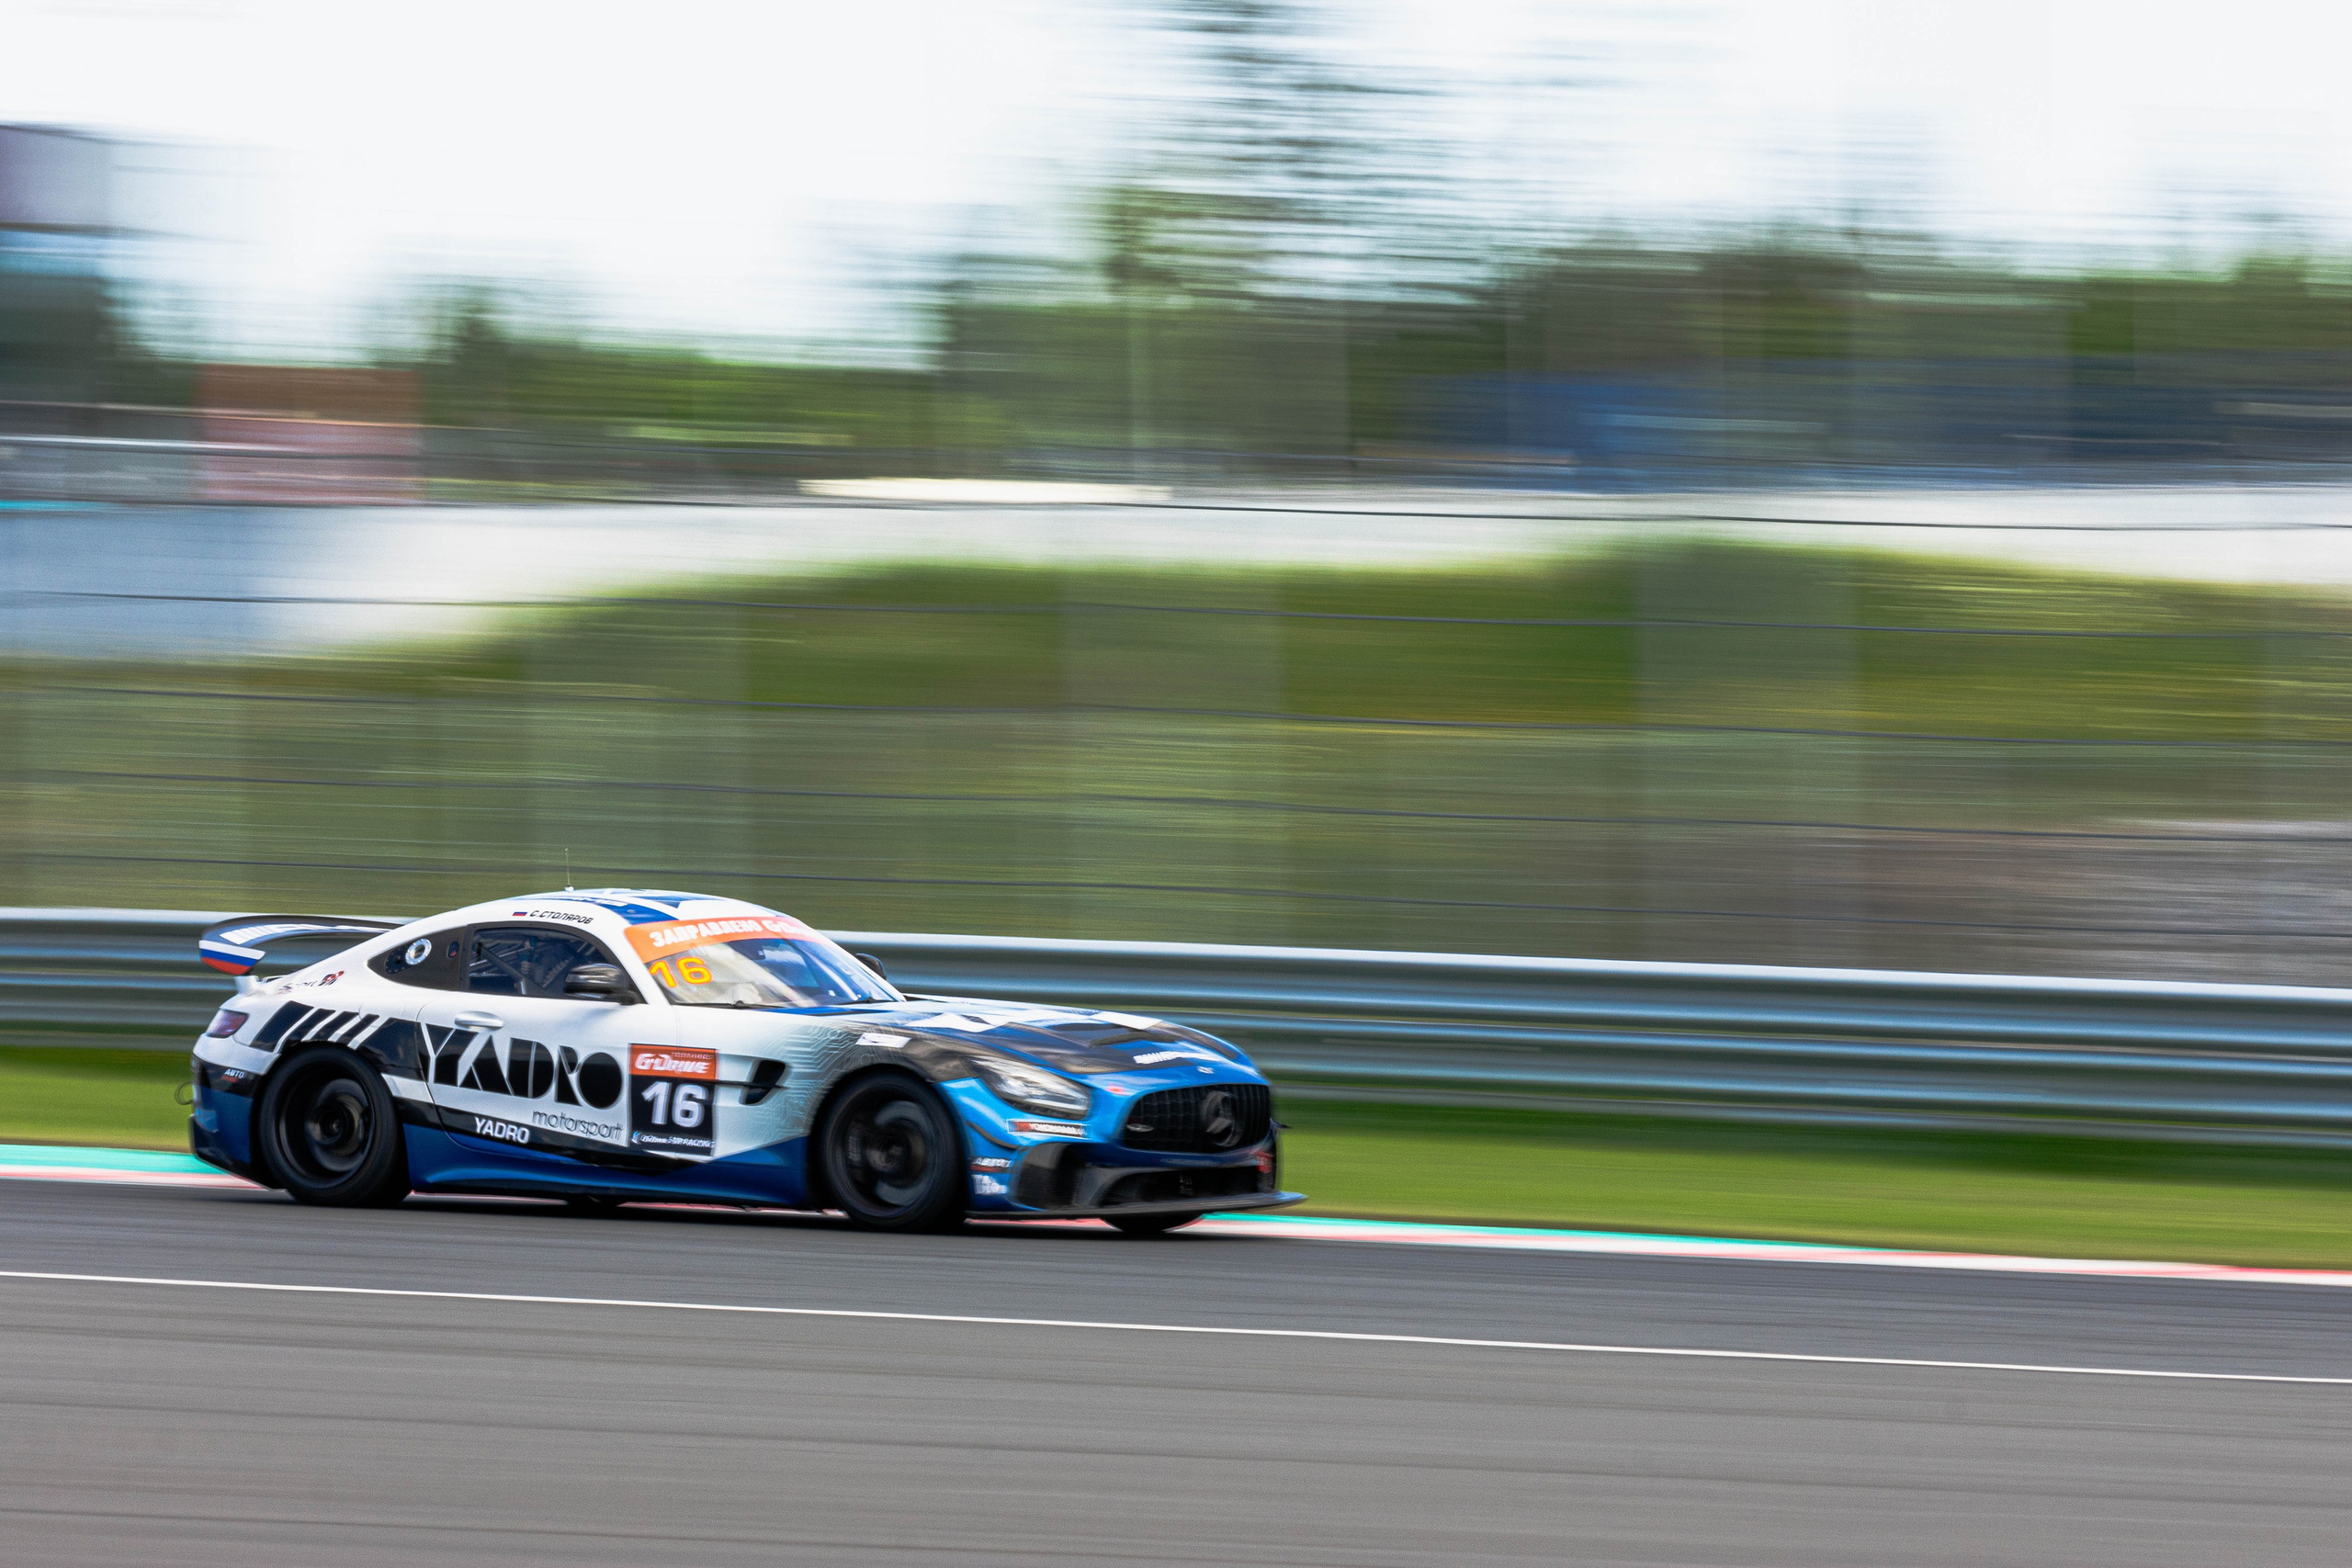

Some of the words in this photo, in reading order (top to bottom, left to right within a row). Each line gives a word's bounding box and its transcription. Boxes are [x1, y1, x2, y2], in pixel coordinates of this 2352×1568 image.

[649, 919, 763, 948] ЗАПРАВЛЕНО
[648, 956, 713, 989] 16
[420, 1021, 624, 1111] YADRO
[641, 1081, 710, 1128] 16
[474, 1116, 530, 1145] YADRO
[531, 1109, 624, 1140] motorsport
